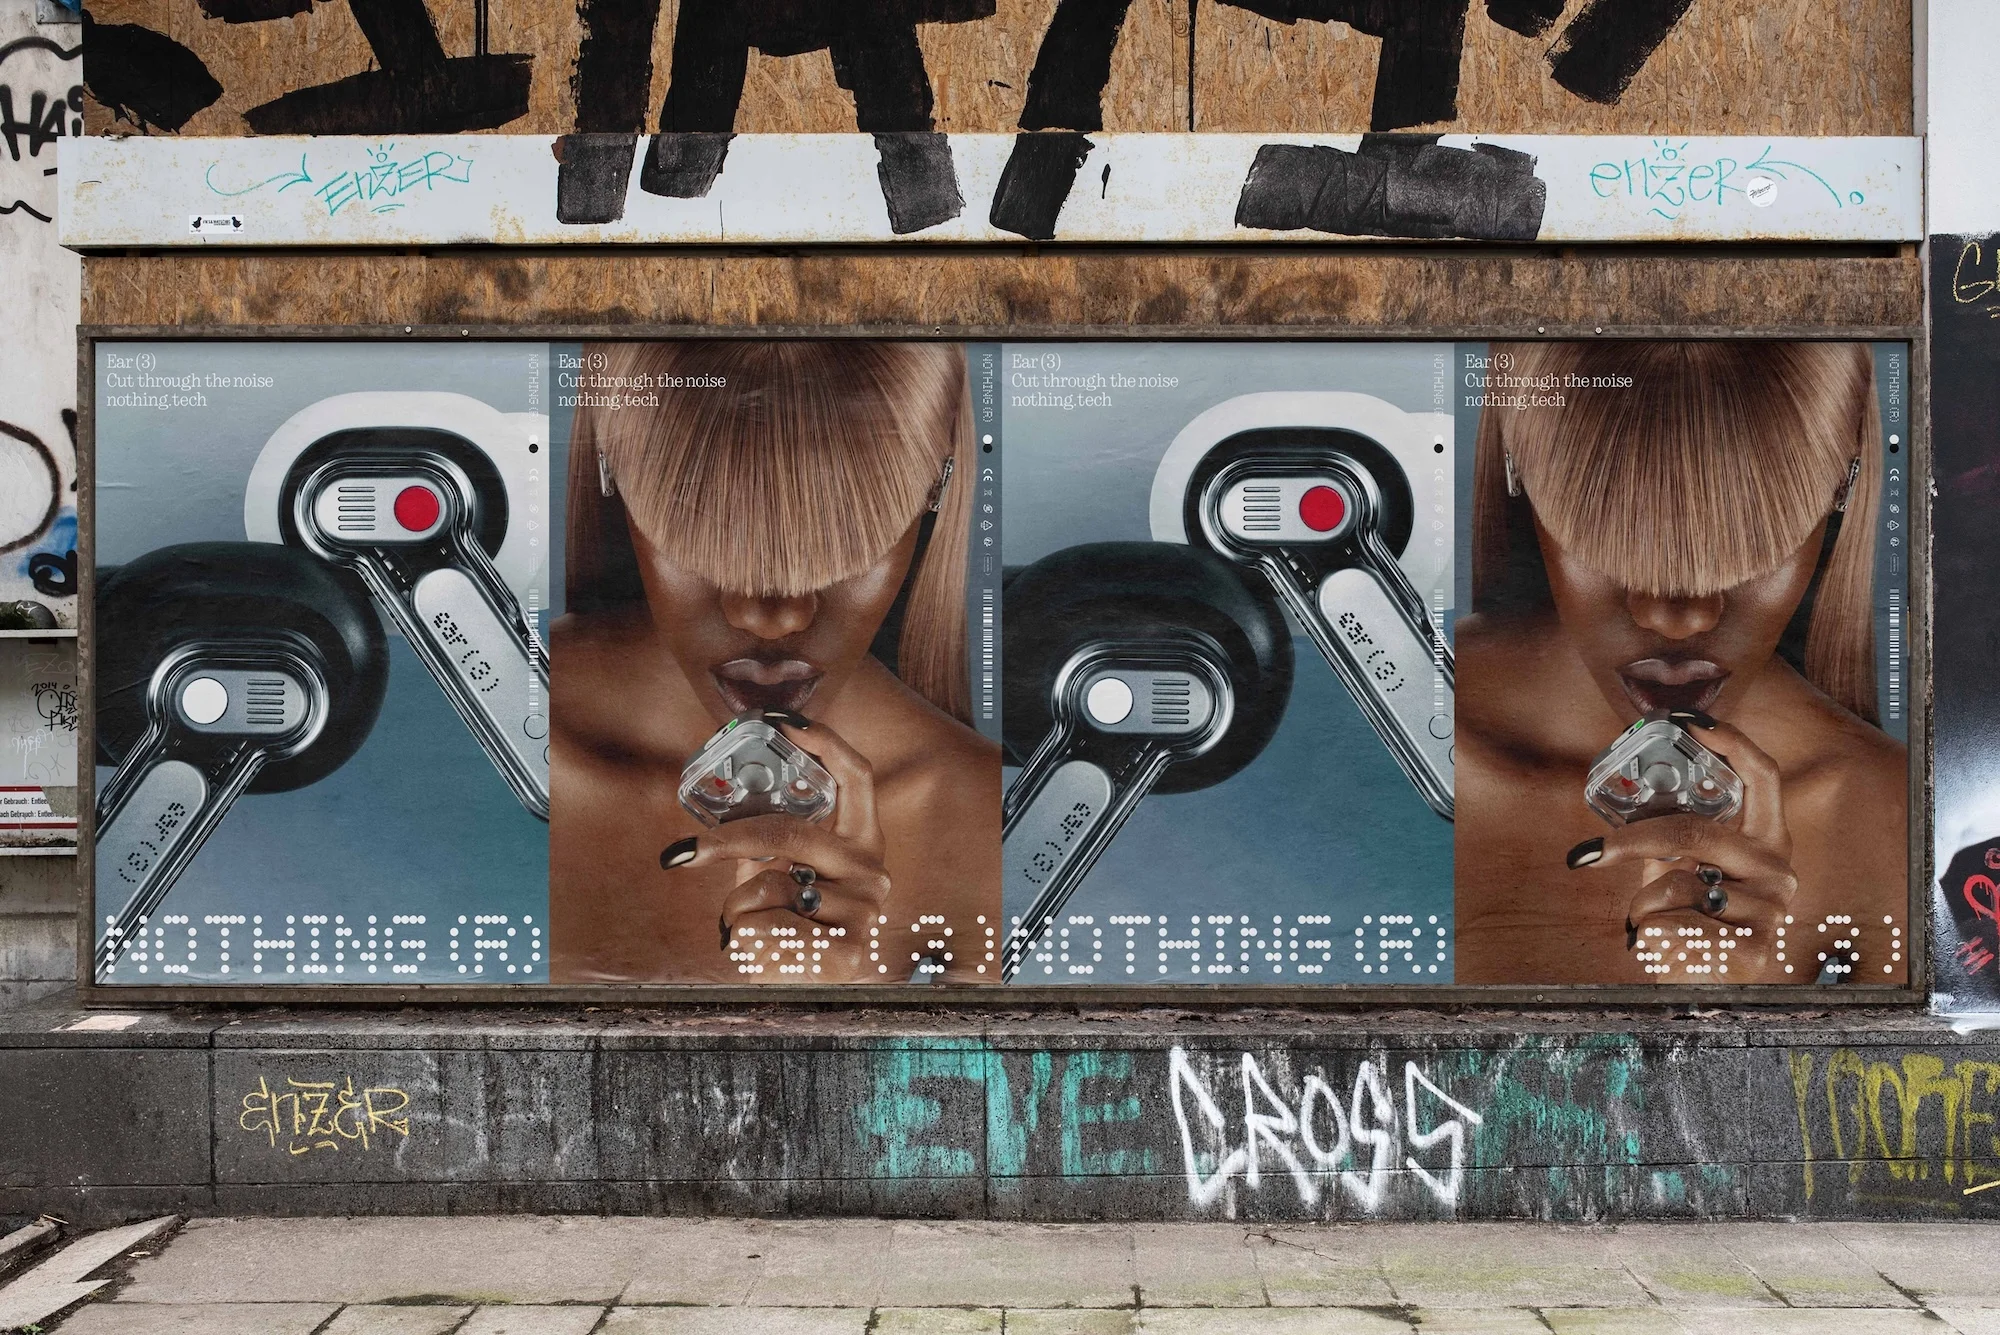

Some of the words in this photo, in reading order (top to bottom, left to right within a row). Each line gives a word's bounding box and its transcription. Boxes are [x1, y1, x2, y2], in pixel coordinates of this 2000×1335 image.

[106, 353, 133, 369] Ear
[136, 352, 156, 371] (3)
[558, 353, 585, 369] Ear
[588, 352, 608, 371] (3)
[1012, 353, 1038, 369] Ear
[1040, 352, 1061, 371] (3)
[1465, 353, 1491, 369] Ear
[1494, 352, 1514, 371] (3)
[106, 373, 134, 388] Cut
[137, 373, 201, 391] through
[204, 373, 231, 388] the
[233, 373, 274, 388] noise
[528, 354, 539, 405] NOTHING
[558, 373, 586, 388] Cut
[589, 373, 653, 391] through
[657, 373, 683, 388] the
[686, 373, 726, 388] noise
[982, 354, 993, 405] NOTHING
[1012, 373, 1039, 388] Cut
[1042, 373, 1106, 391] through
[1110, 373, 1136, 388] the
[1138, 373, 1178, 388] noise
[1434, 354, 1444, 405] NOTHING
[1465, 373, 1492, 388] Cut
[1496, 373, 1560, 391] through
[1564, 373, 1590, 388] the
[1592, 373, 1632, 388] noise
[1889, 354, 1899, 405] NOTHING
[106, 392, 207, 410] nothing.tech
[558, 392, 659, 410] nothing.tech
[1012, 392, 1112, 410] nothing.tech
[1465, 392, 1566, 410] nothing.tech
[982, 407, 993, 423] (R)
[1889, 407, 1899, 423] (R)
[434, 612, 468, 645] ear
[1339, 612, 1373, 645] ear
[0, 810, 9, 818] ach
[106, 915, 426, 974] NOTHING
[450, 915, 541, 974] (R)
[730, 927, 847, 974] ear
[869, 914, 994, 974] (3)
[1011, 915, 1331, 974] NOTHING
[1355, 915, 1446, 974] (R)
[1636, 927, 1752, 974] ear
[1776, 914, 1900, 974] (3)
